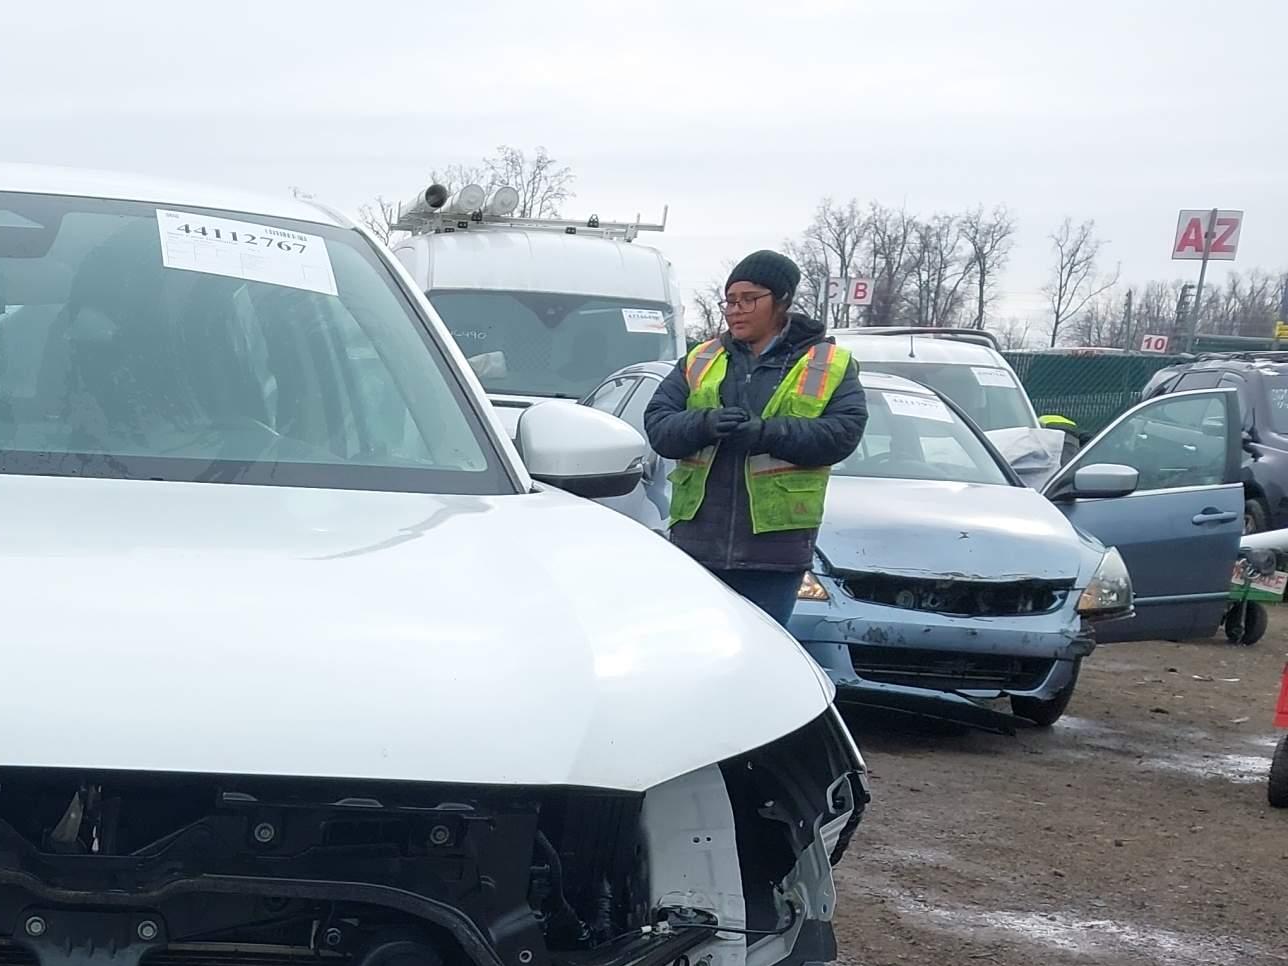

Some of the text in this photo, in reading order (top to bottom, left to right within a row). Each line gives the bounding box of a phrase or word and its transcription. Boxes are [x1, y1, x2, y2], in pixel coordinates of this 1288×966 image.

[176, 223, 307, 254] 44112767
[854, 282, 868, 300] B
[1144, 336, 1166, 351] 10
